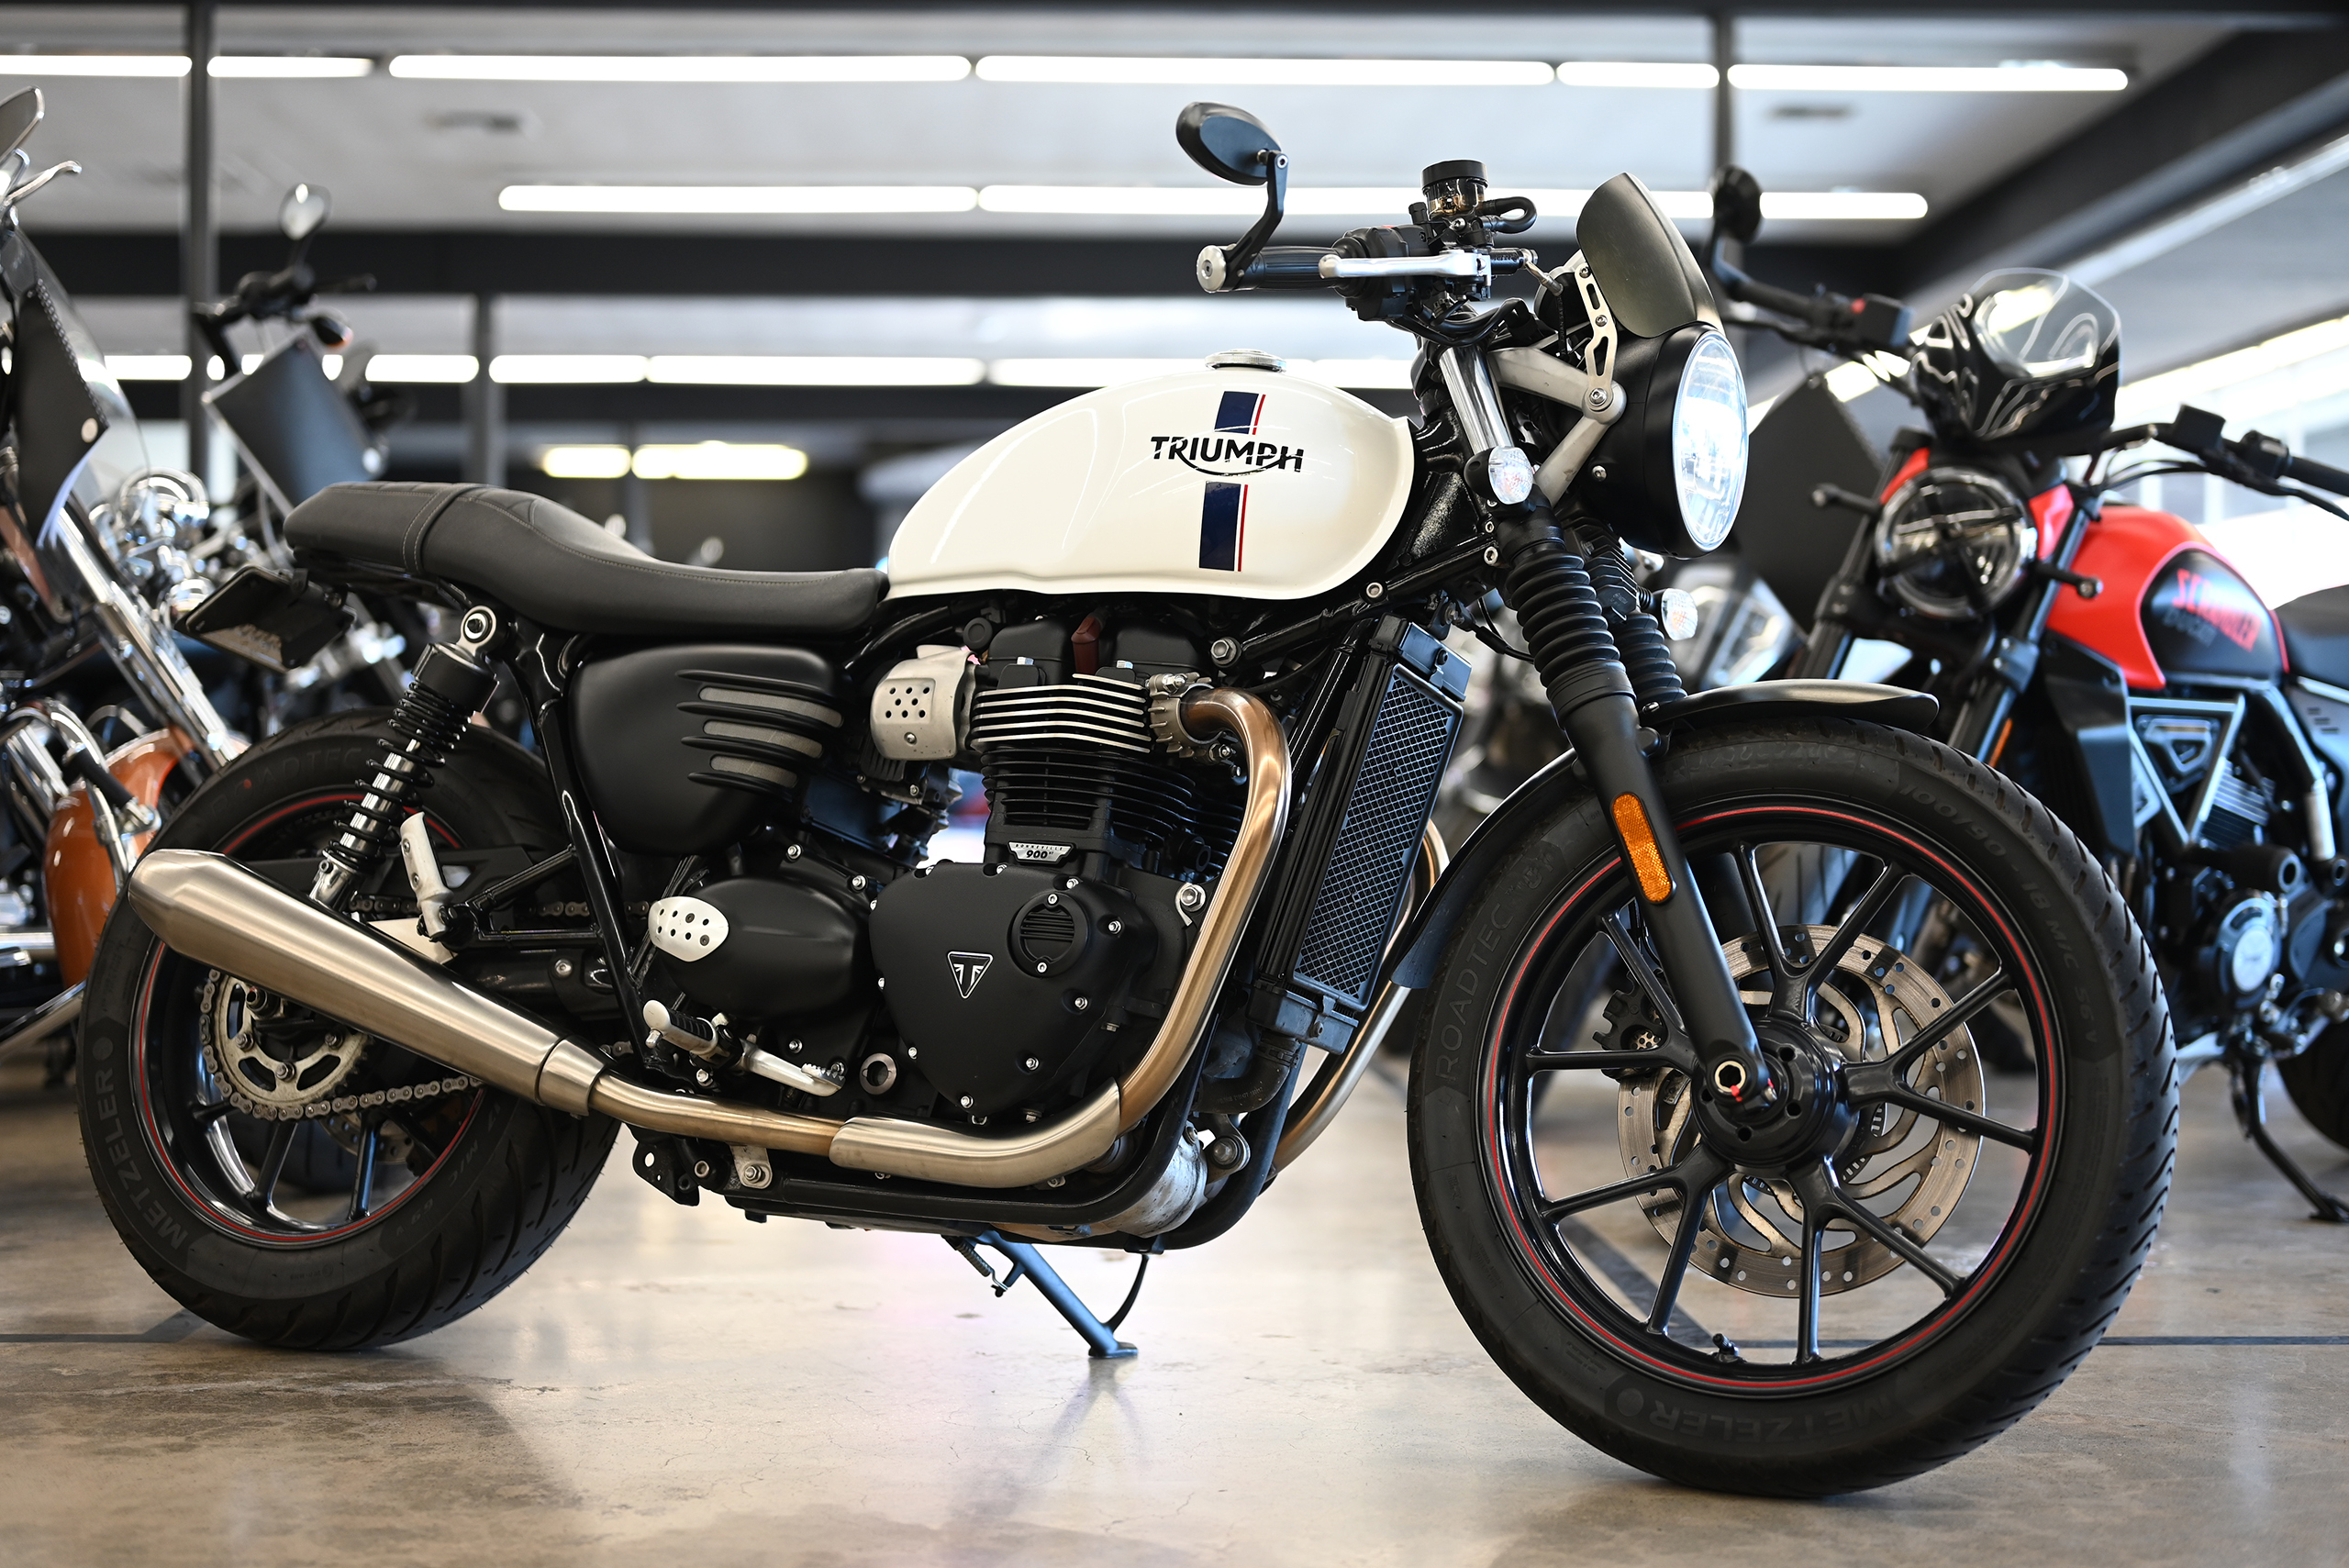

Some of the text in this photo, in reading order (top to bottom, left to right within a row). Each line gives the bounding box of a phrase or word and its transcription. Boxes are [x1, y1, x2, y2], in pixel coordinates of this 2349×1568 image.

[1151, 436, 1304, 476] TRIUMPH
[1026, 850, 1048, 859] 900
[1899, 784, 2007, 857] 100/90
[2021, 881, 2052, 909] 18
[1435, 902, 1514, 1083] ROADTEC
[95, 1067, 189, 1251] METZELER
[1649, 1392, 1896, 1443] METZELER
